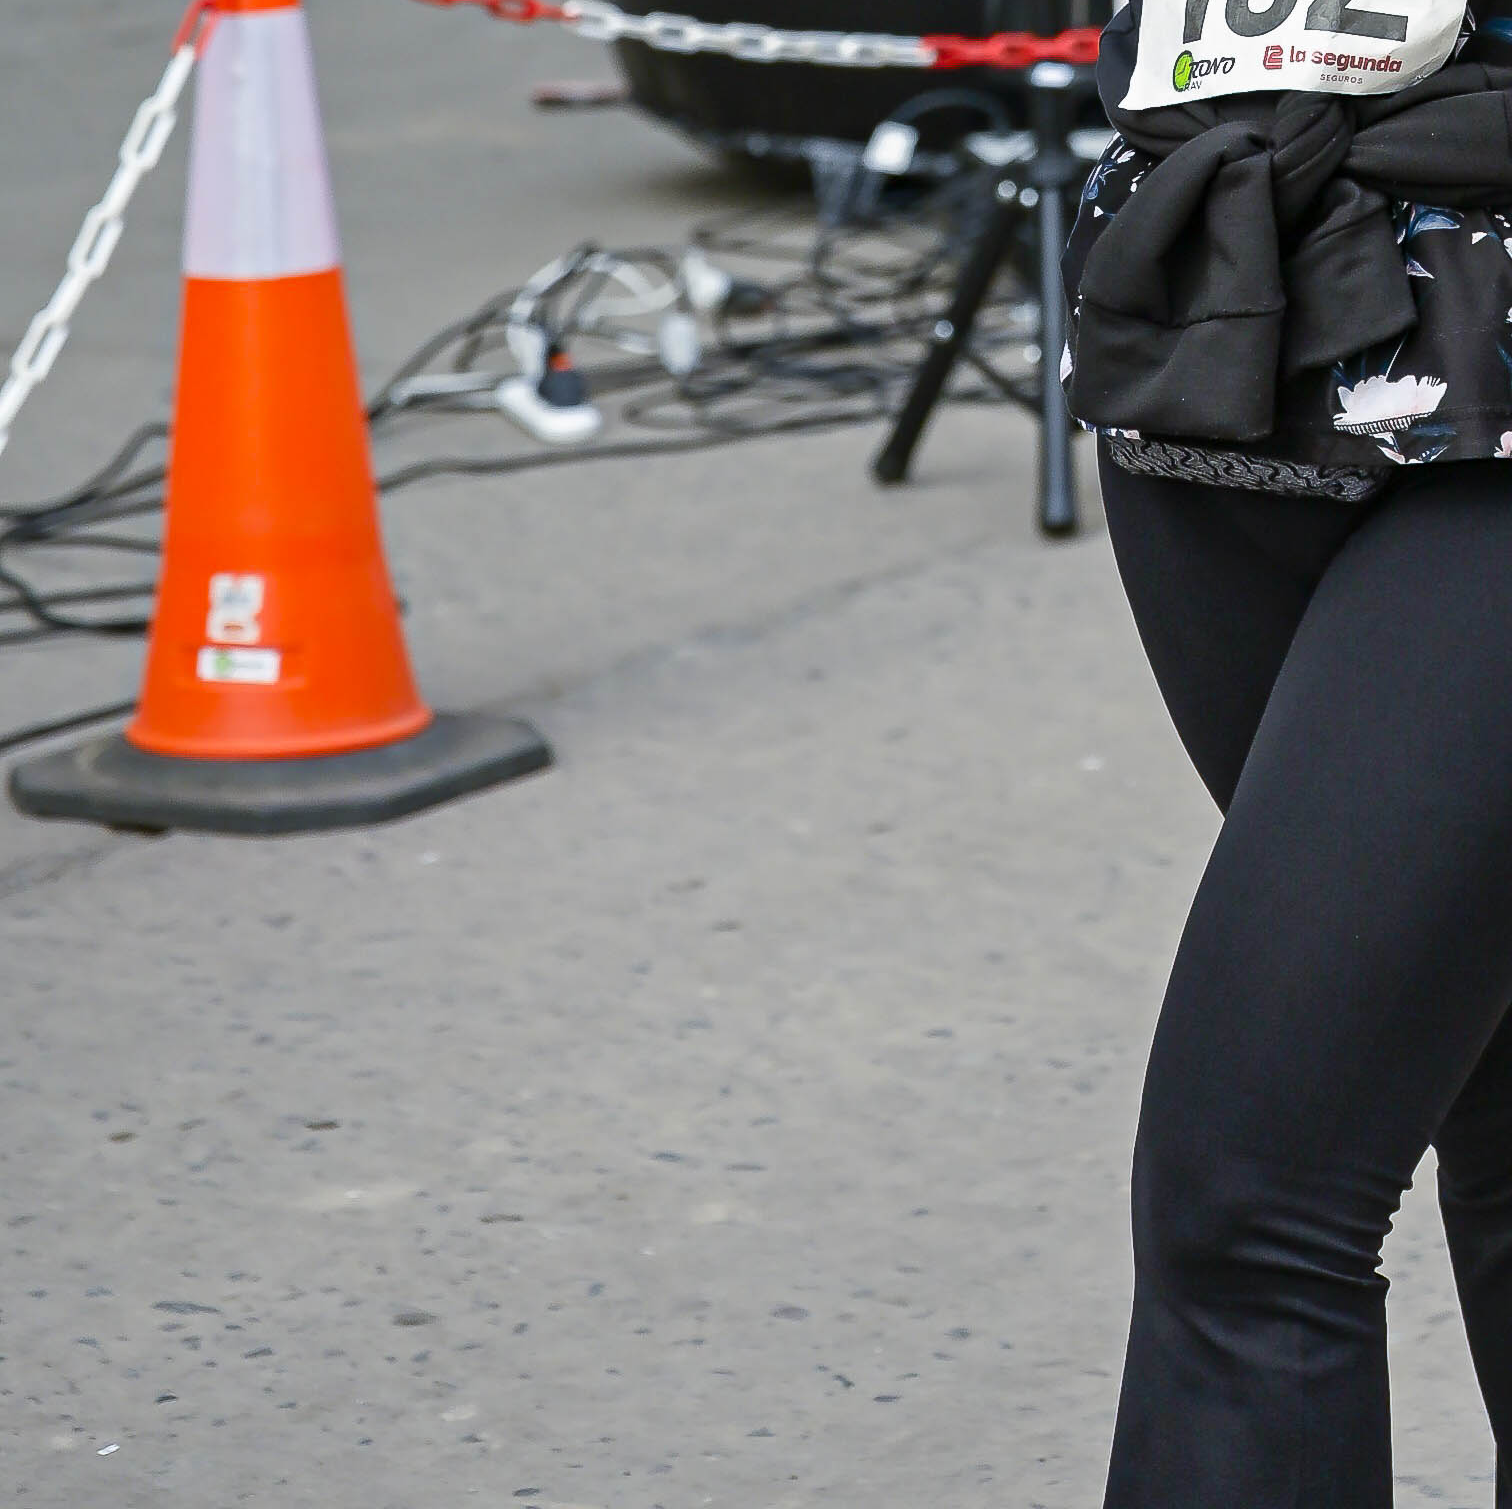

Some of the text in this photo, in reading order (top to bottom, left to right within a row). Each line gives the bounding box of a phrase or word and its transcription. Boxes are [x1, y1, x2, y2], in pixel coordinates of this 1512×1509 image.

[1290, 45, 1306, 63] la
[1311, 50, 1403, 73] segunda
[1319, 73, 1363, 85] SEGUROS
